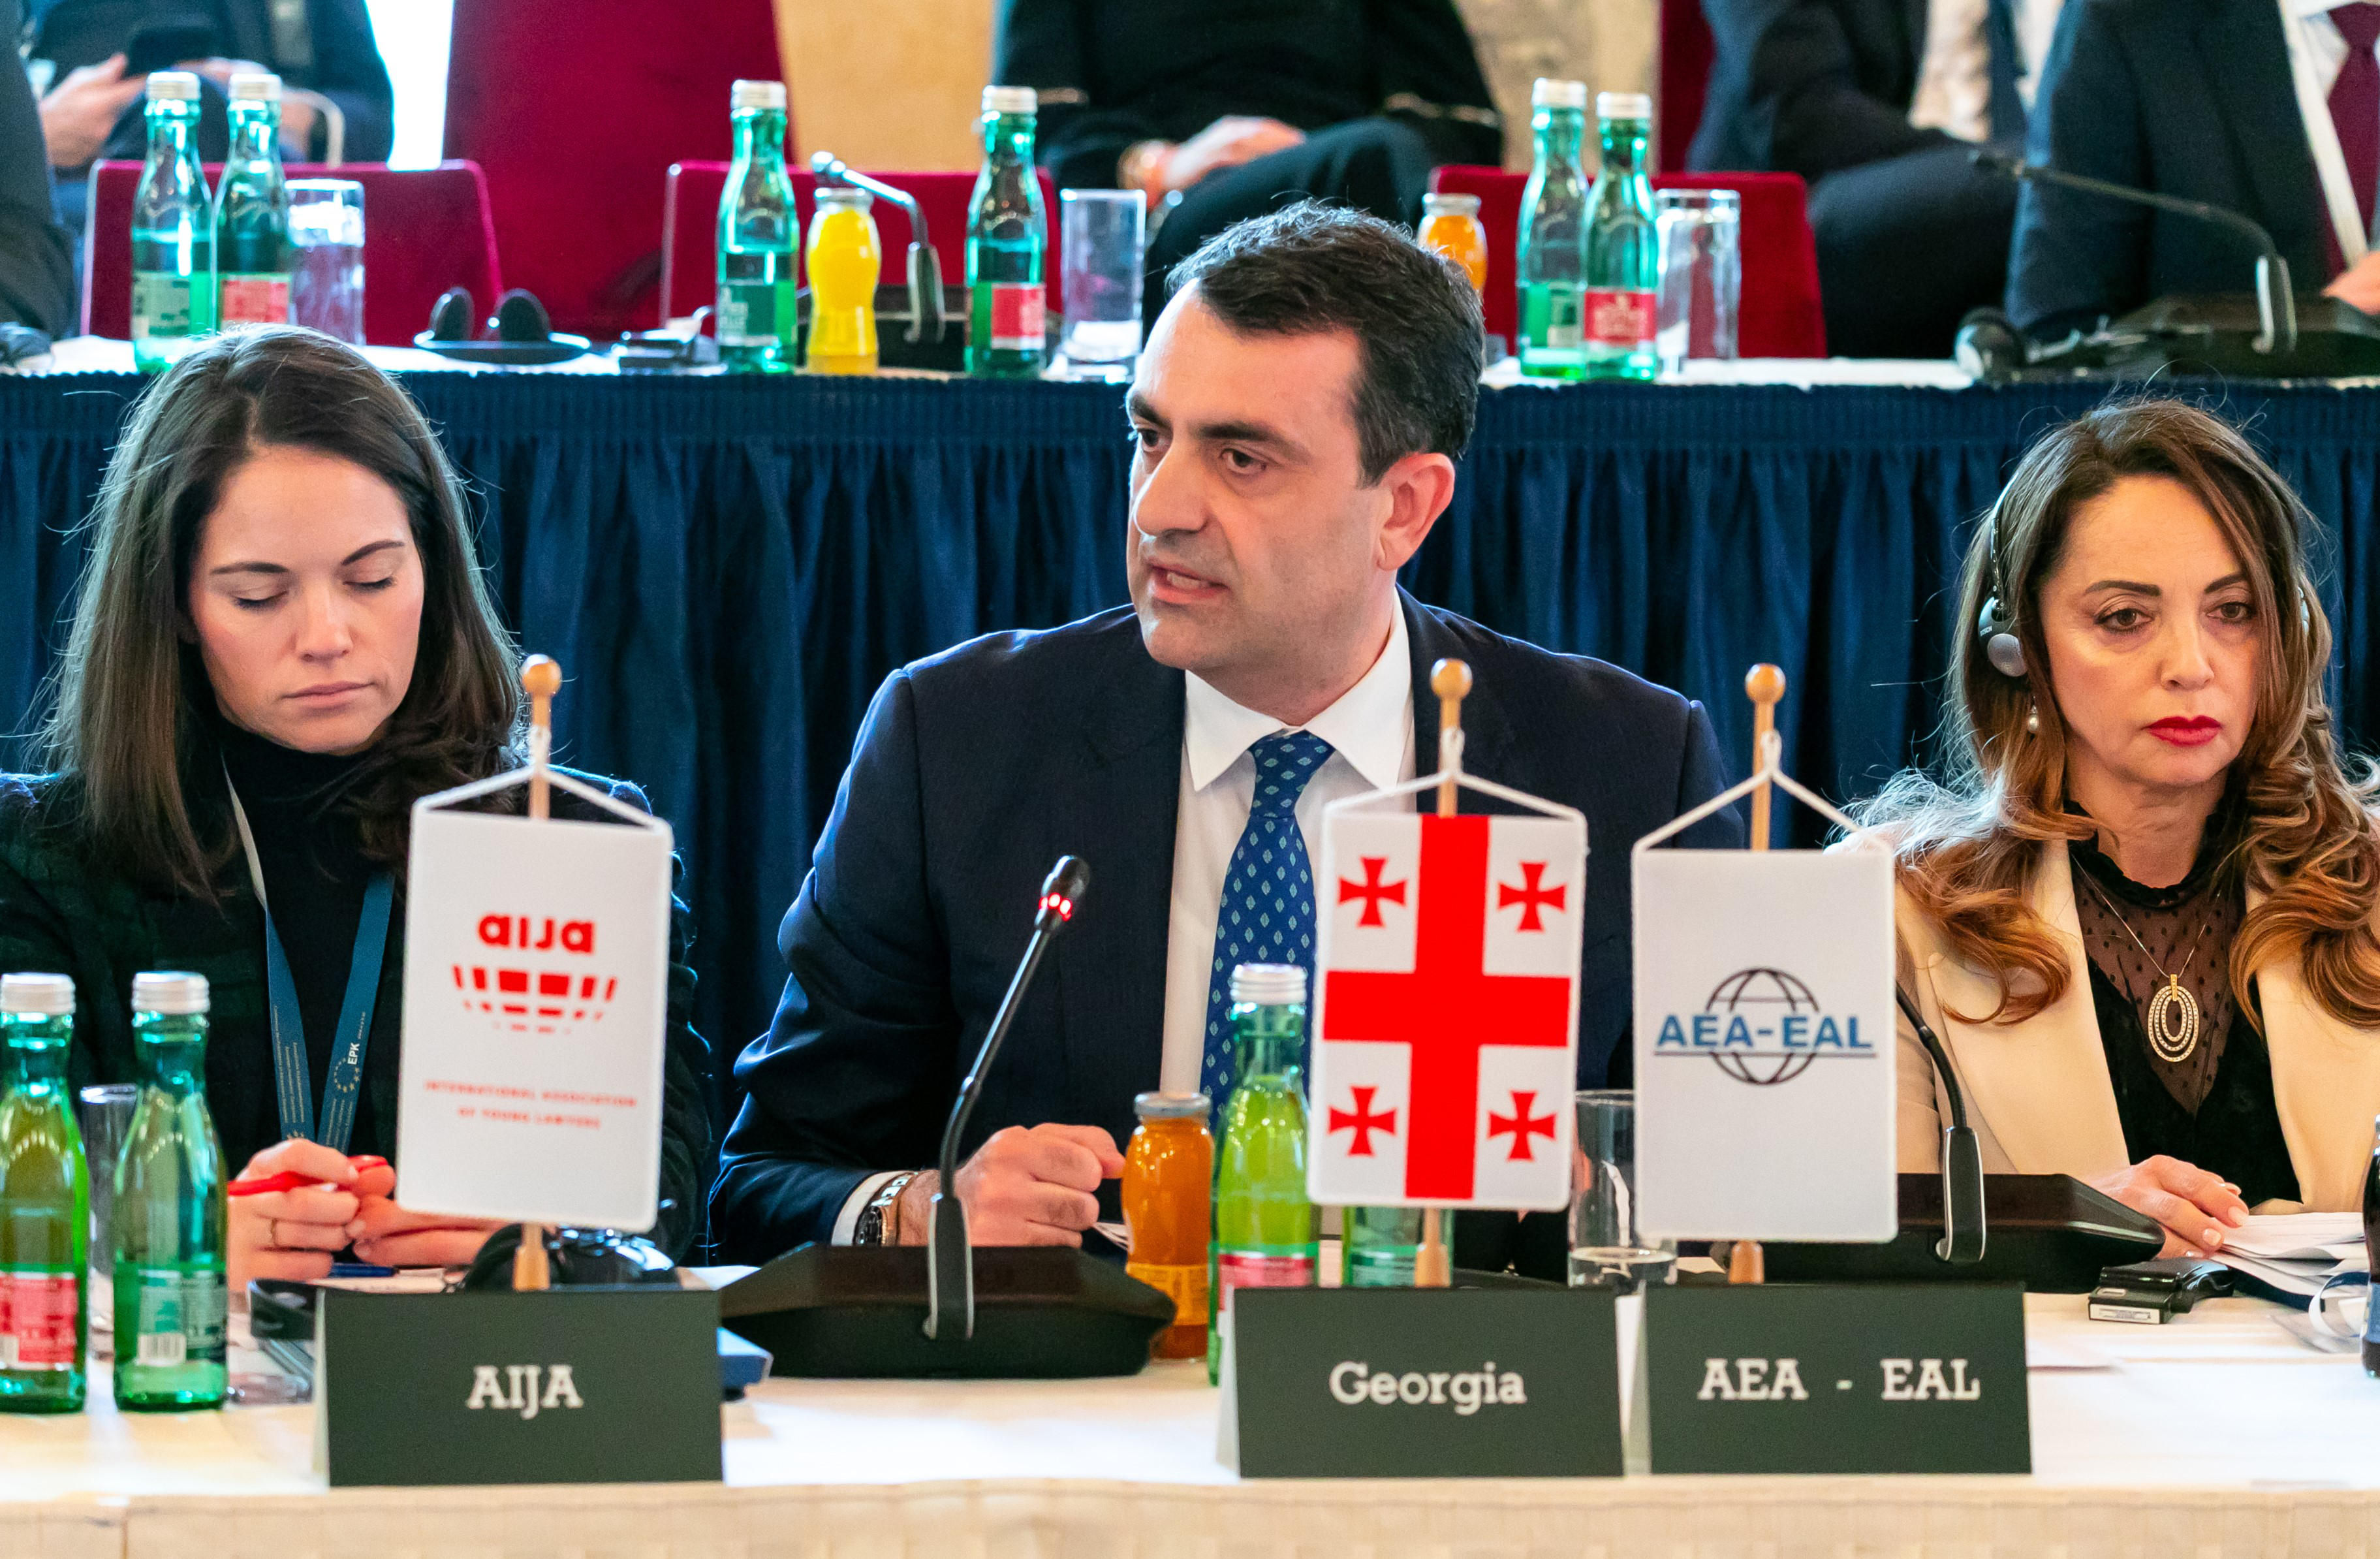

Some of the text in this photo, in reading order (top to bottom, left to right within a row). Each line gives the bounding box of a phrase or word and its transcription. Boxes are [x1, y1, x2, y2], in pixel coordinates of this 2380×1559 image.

[347, 1043, 360, 1065] EPK
[467, 1364, 584, 1419] AIJA
[1329, 1361, 1527, 1415] Georgia
[1698, 1358, 1809, 1400] AEA
[1880, 1359, 1981, 1400] EAL
